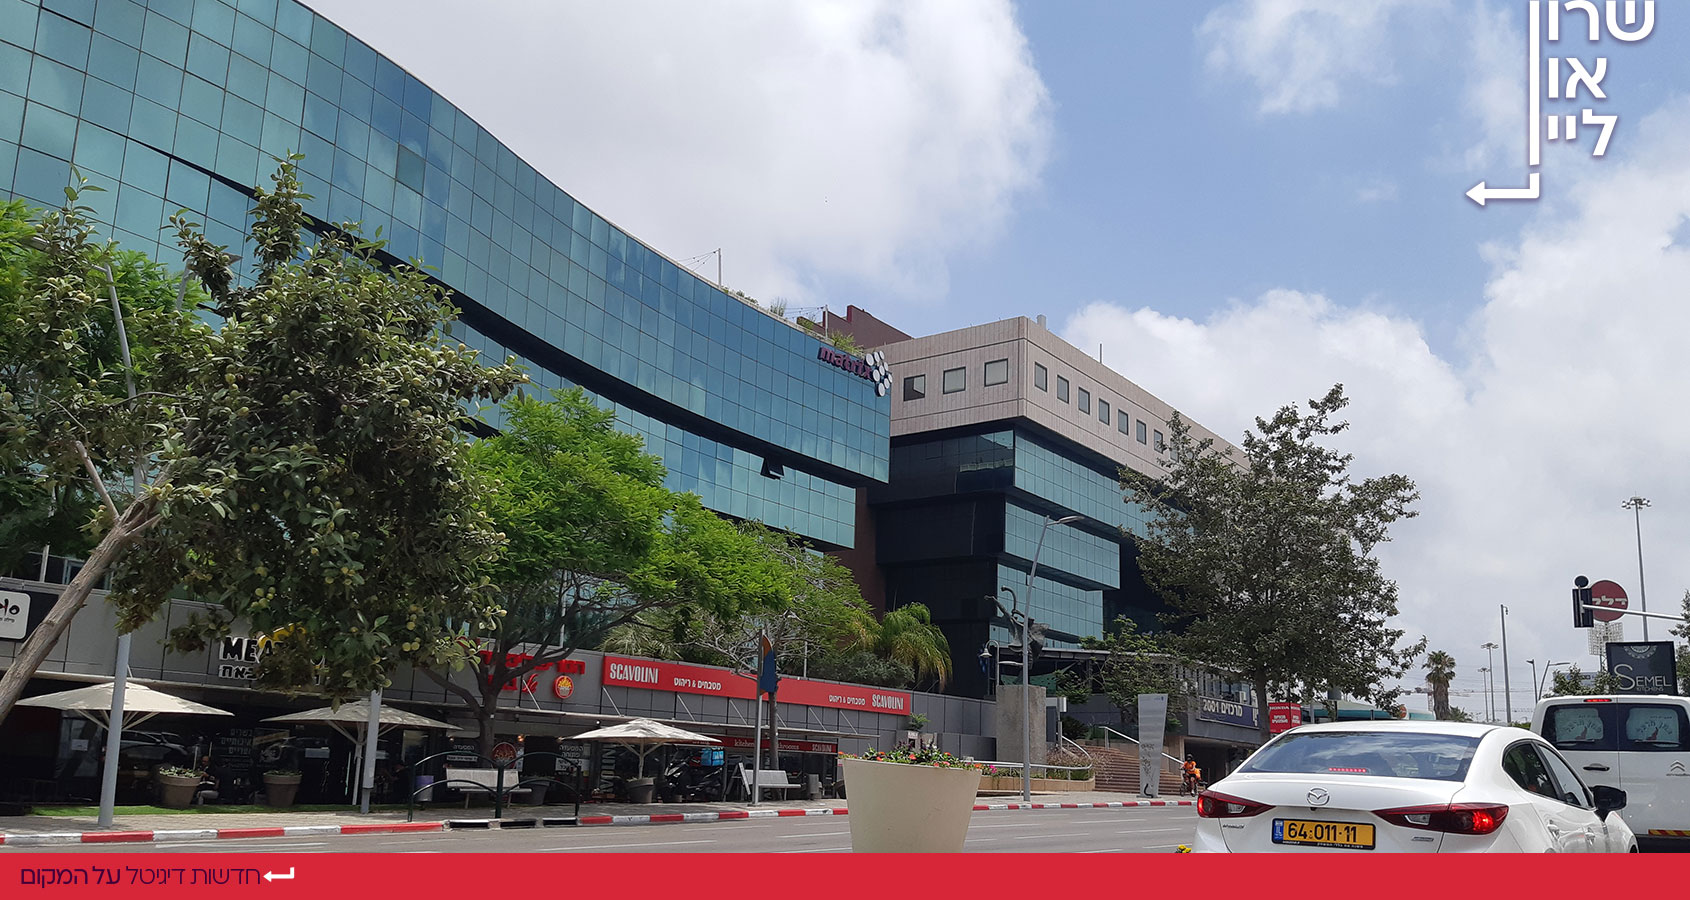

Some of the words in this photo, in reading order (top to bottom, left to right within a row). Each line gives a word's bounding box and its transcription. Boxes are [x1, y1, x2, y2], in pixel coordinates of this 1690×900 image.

[818, 346, 873, 381] matrix
[609, 662, 659, 684] SCAVOLINI
[1613, 663, 1671, 690] SEMEL
[673, 677, 691, 687] ריהוט
[697, 680, 721, 691] מטבחים
[828, 695, 842, 704] ריהוט
[846, 697, 866, 706] מטבחים
[871, 694, 904, 710] SCAVOLINI
[1203, 699, 1219, 713] 2001
[1221, 702, 1243, 717] מרכזים
